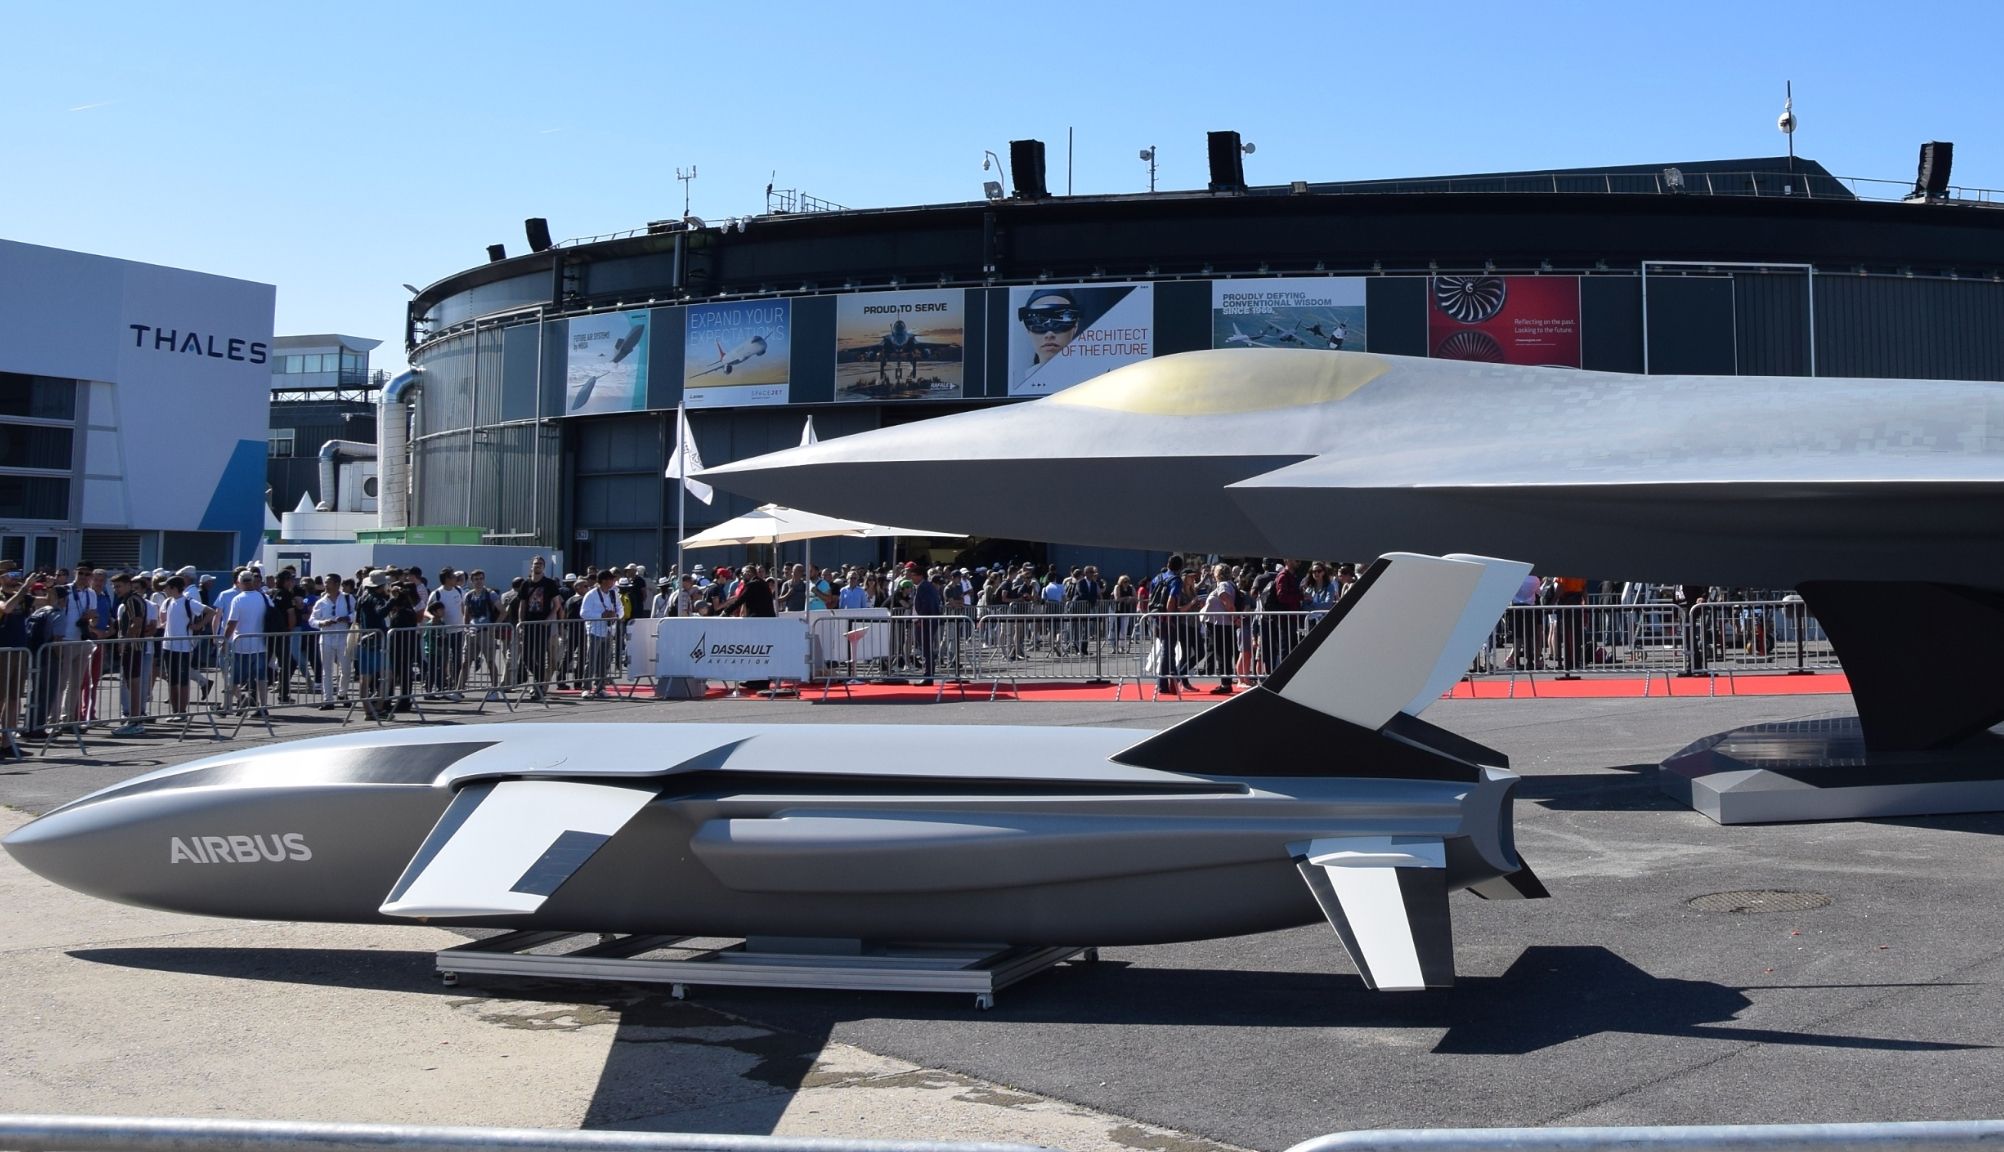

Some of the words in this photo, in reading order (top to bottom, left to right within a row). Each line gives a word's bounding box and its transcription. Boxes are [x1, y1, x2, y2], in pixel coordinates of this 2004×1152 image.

[1222, 292, 1264, 300] PROUDLY
[1266, 292, 1306, 300] DEFYING
[863, 304, 897, 315] PROUD
[899, 304, 912, 313] TO
[914, 302, 948, 312] SERVE
[1222, 299, 1292, 308] CONVENTIONAL
[691, 310, 742, 329] EXPAND
[745, 307, 784, 325] YOUR
[1222, 307, 1250, 315] SINCE
[690, 325, 785, 346] EXPECTATIONS
[1077, 328, 1149, 342] ARCHITECT
[129, 324, 267, 364] THALES
[1061, 345, 1076, 357] OF
[1079, 344, 1101, 357] THE
[1102, 343, 1149, 356] FUTURE
[710, 644, 774, 655] DASSAULT
[171, 833, 313, 864] AIRBUS
